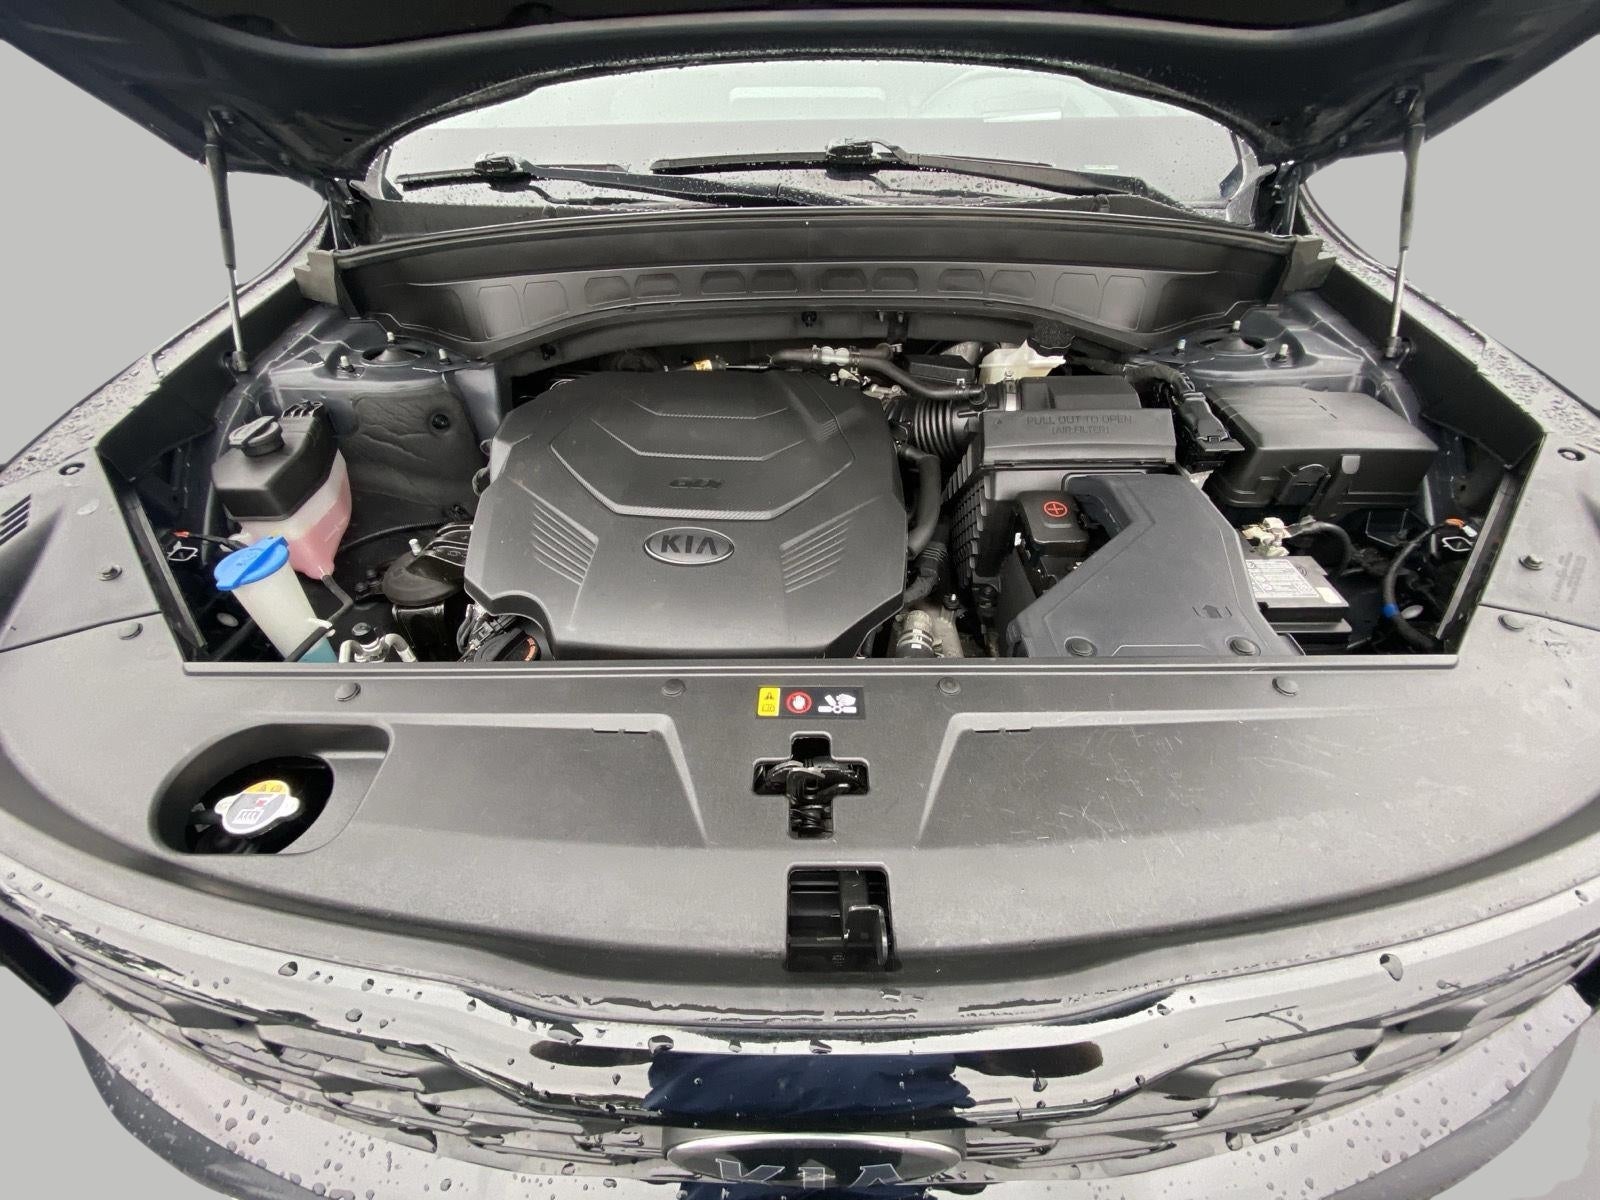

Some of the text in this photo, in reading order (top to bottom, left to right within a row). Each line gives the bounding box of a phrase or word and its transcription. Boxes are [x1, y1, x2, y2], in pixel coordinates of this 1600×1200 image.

[1026, 414, 1132, 425] PULL OUT TO OPEN
[660, 534, 718, 556] KIA
